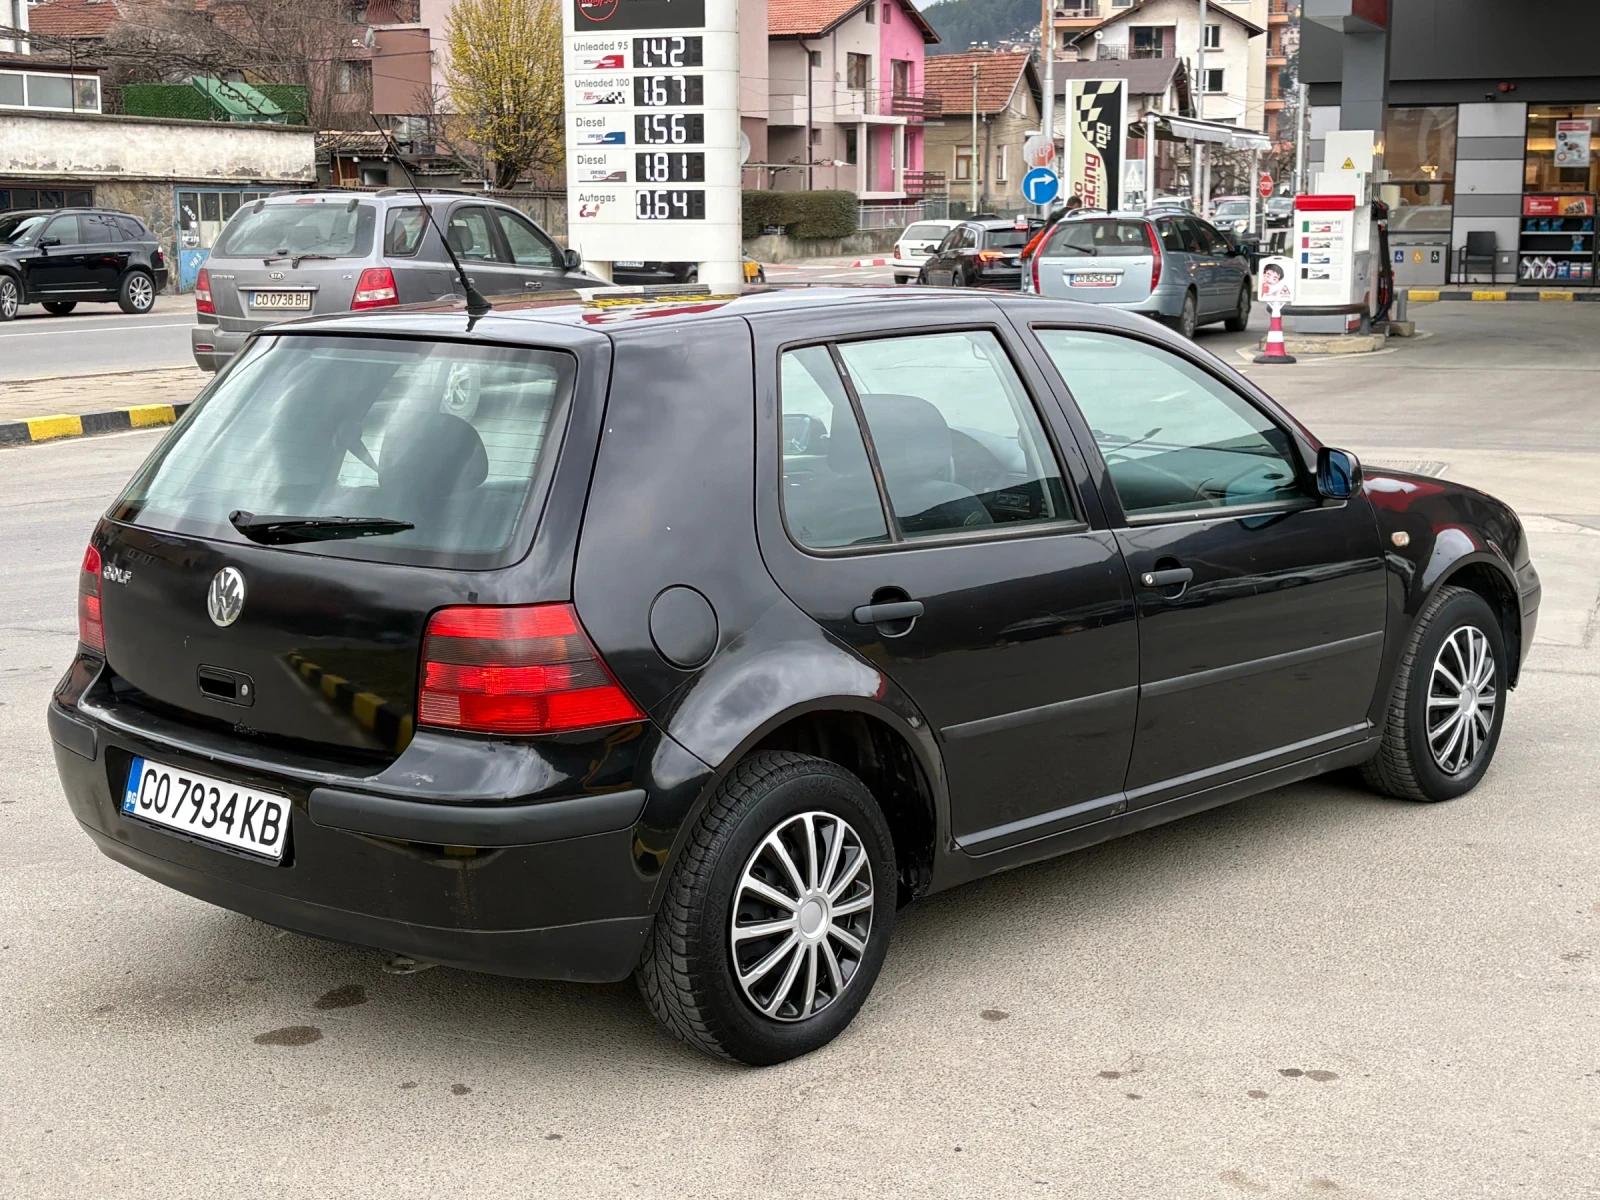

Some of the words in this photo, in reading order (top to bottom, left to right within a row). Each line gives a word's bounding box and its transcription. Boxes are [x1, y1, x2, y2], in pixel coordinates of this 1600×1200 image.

[574, 41, 614, 52] Unleaded
[617, 41, 628, 50] 95
[643, 36, 685, 67] 1.42
[574, 79, 613, 88] Unleaded
[616, 78, 630, 87] 100
[643, 75, 686, 106] 1.67
[576, 117, 606, 127] Diesel
[644, 113, 686, 144] 1.56
[1096, 122, 1107, 149] 100
[577, 154, 606, 165] Diesel
[645, 152, 687, 182] 1.81
[1084, 152, 1101, 208] acing
[578, 193, 616, 204] Autogas
[636, 190, 687, 219] 0.64
[255, 294, 268, 306] CO
[270, 293, 293, 306] 0738
[295, 293, 309, 306] BH
[103, 565, 132, 583] GOLF
[126, 790, 137, 805] BG
[139, 768, 171, 814] CO
[171, 777, 239, 836] 7934
[239, 796, 282, 847] KB
